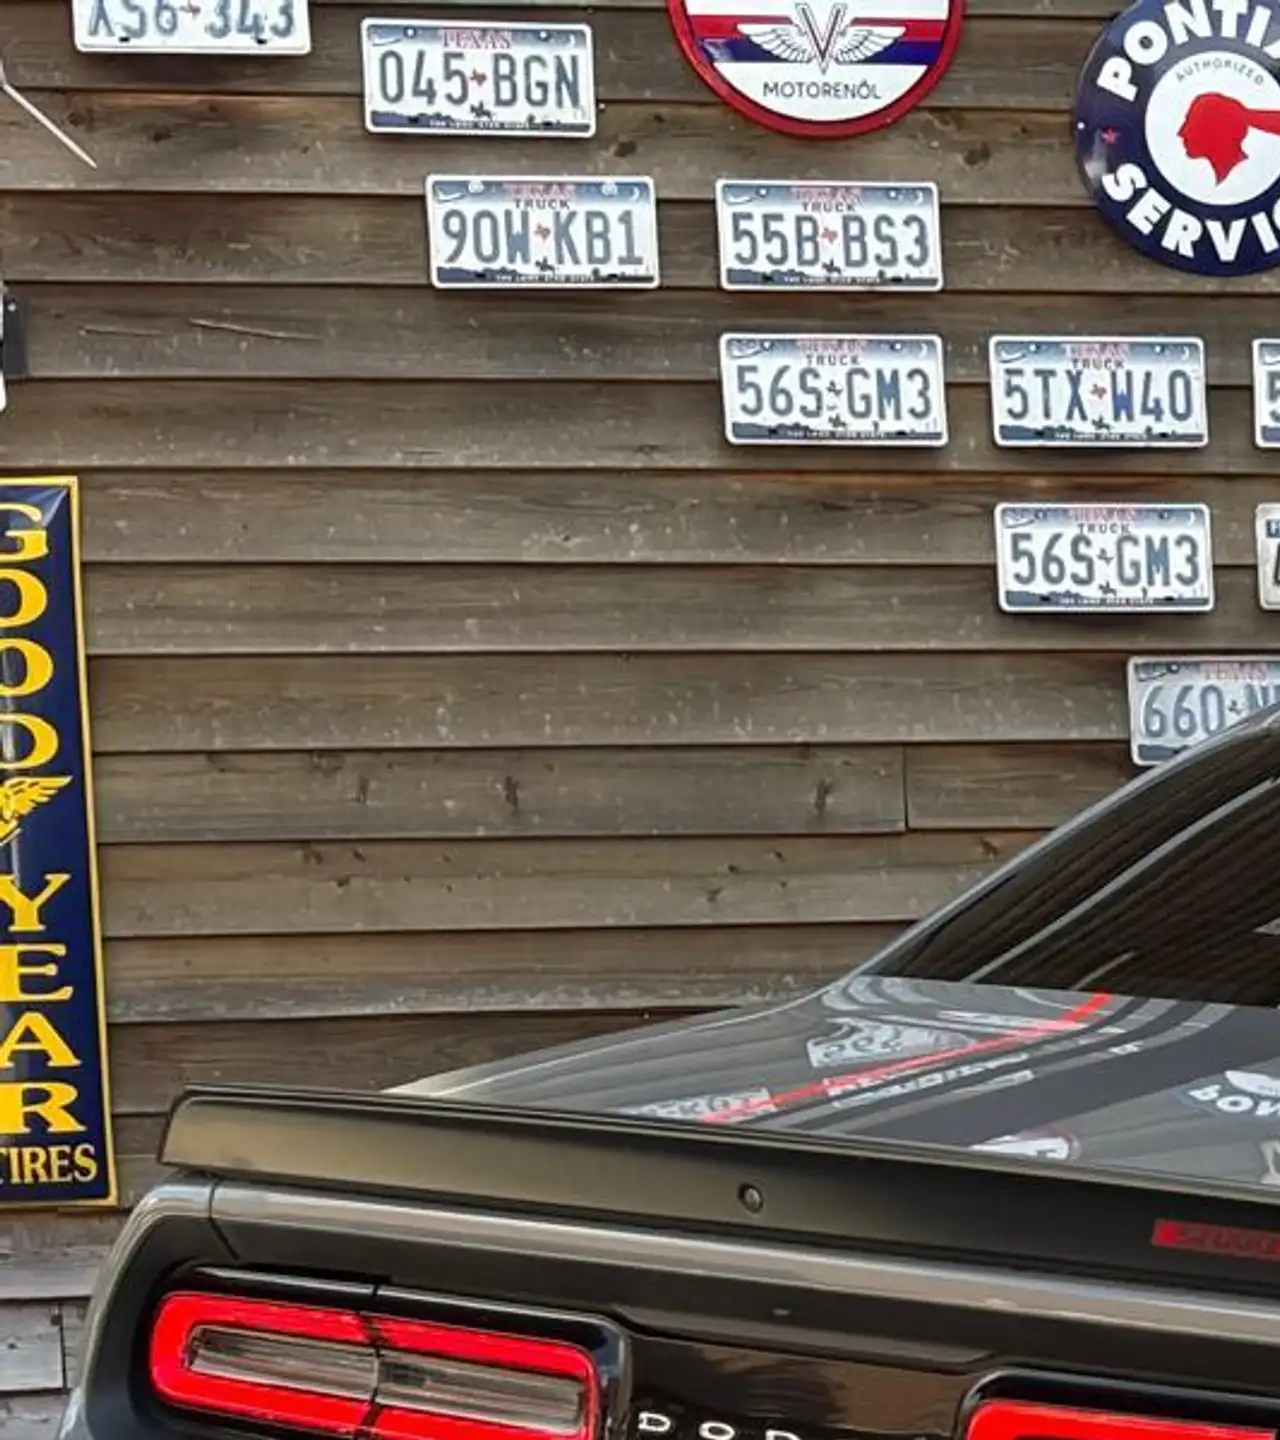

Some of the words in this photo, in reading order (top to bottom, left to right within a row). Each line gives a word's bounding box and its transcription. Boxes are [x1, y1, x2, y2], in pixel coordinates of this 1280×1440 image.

[379, 50, 470, 105] 045
[492, 53, 582, 109] BGN
[1176, 57, 1264, 85] AUTHORIZED
[442, 208, 531, 265] 90W
[554, 210, 645, 266] KB1
[731, 212, 820, 267] 55B
[842, 214, 930, 268] BS3
[806, 354, 861, 366] TRUCK
[736, 365, 824, 419] 56S
[845, 367, 932, 420] GM3
[1003, 368, 1088, 421] 5TX
[1110, 369, 1193, 422] W40
[1077, 523, 1132, 535] TRUCK
[1010, 532, 1096, 586] 56S
[1116, 534, 1200, 587] GM3
[1142, 683, 1227, 739] 660
[0, 1143, 98, 1184] IRES
